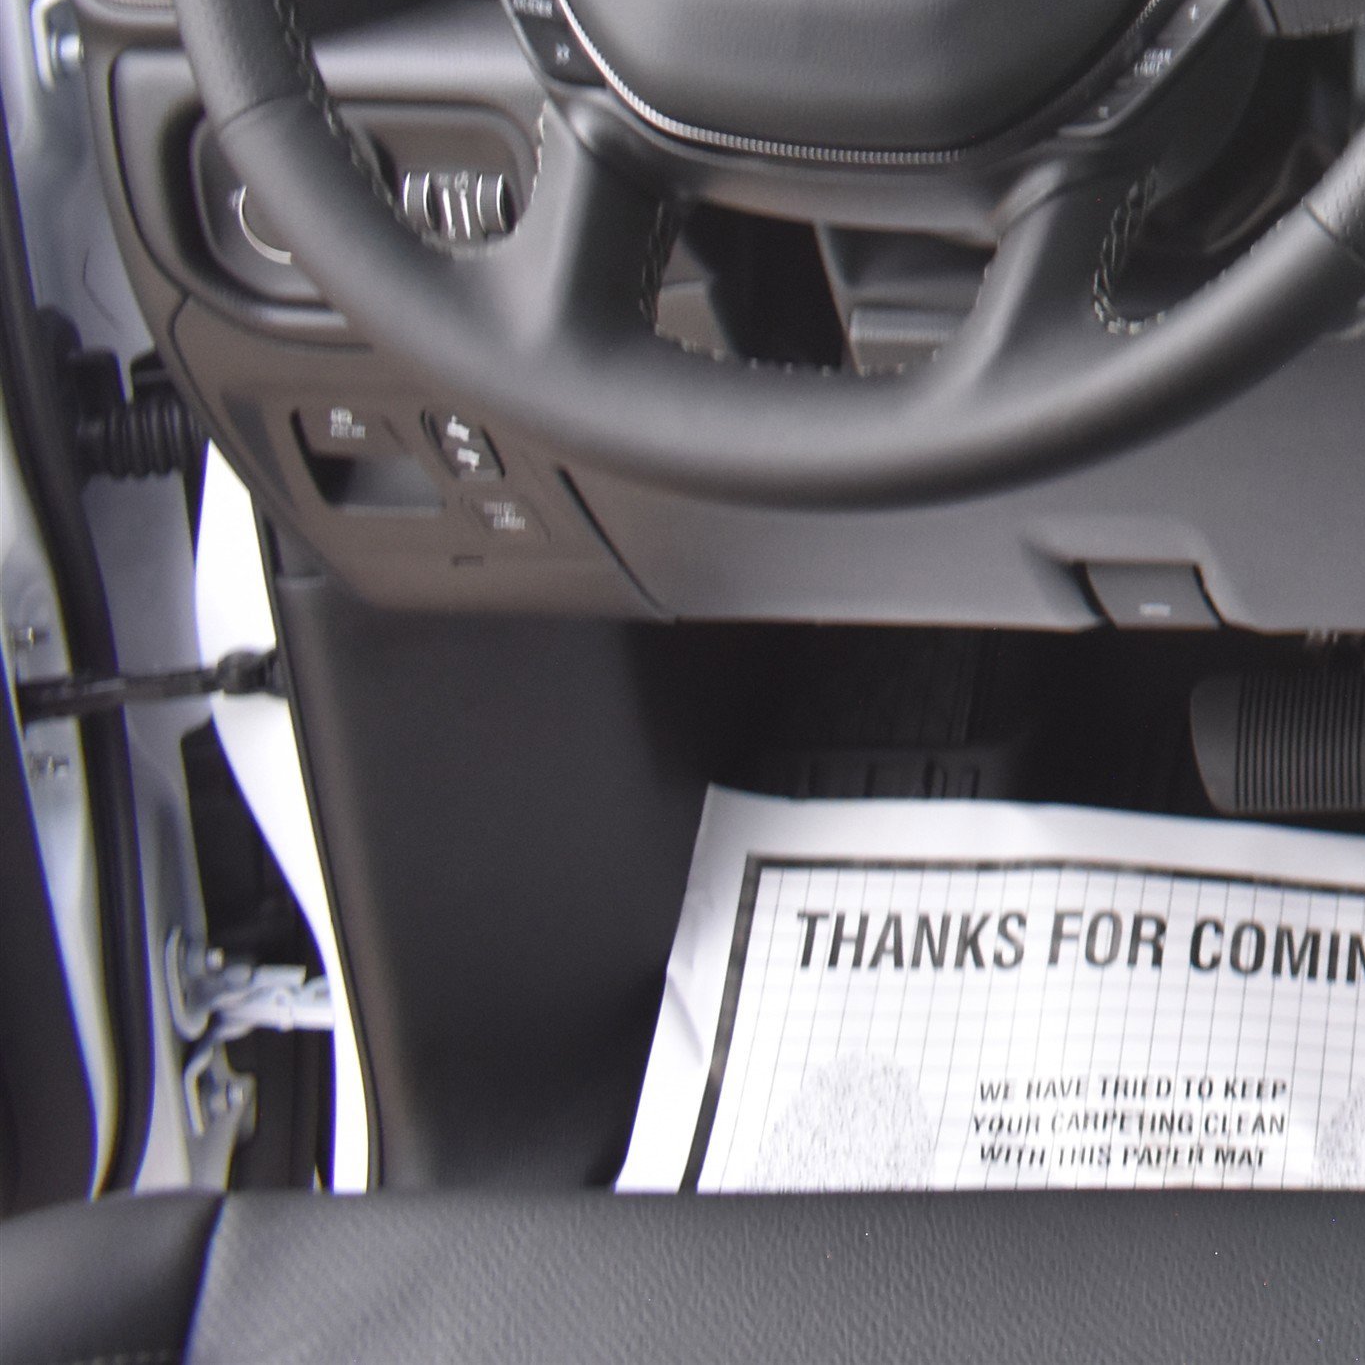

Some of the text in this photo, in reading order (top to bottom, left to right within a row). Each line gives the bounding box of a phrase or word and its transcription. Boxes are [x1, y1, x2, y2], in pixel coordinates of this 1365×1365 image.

[796, 906, 1028, 970] THANKS
[1047, 906, 1169, 971] FOR
[979, 1075, 1288, 1102] WE HAVE TRIED TO KEEP
[973, 1110, 1286, 1136] YOUR CARPETING CLEAN
[979, 1143, 1267, 1168] WITH THIS PAPER MAT
